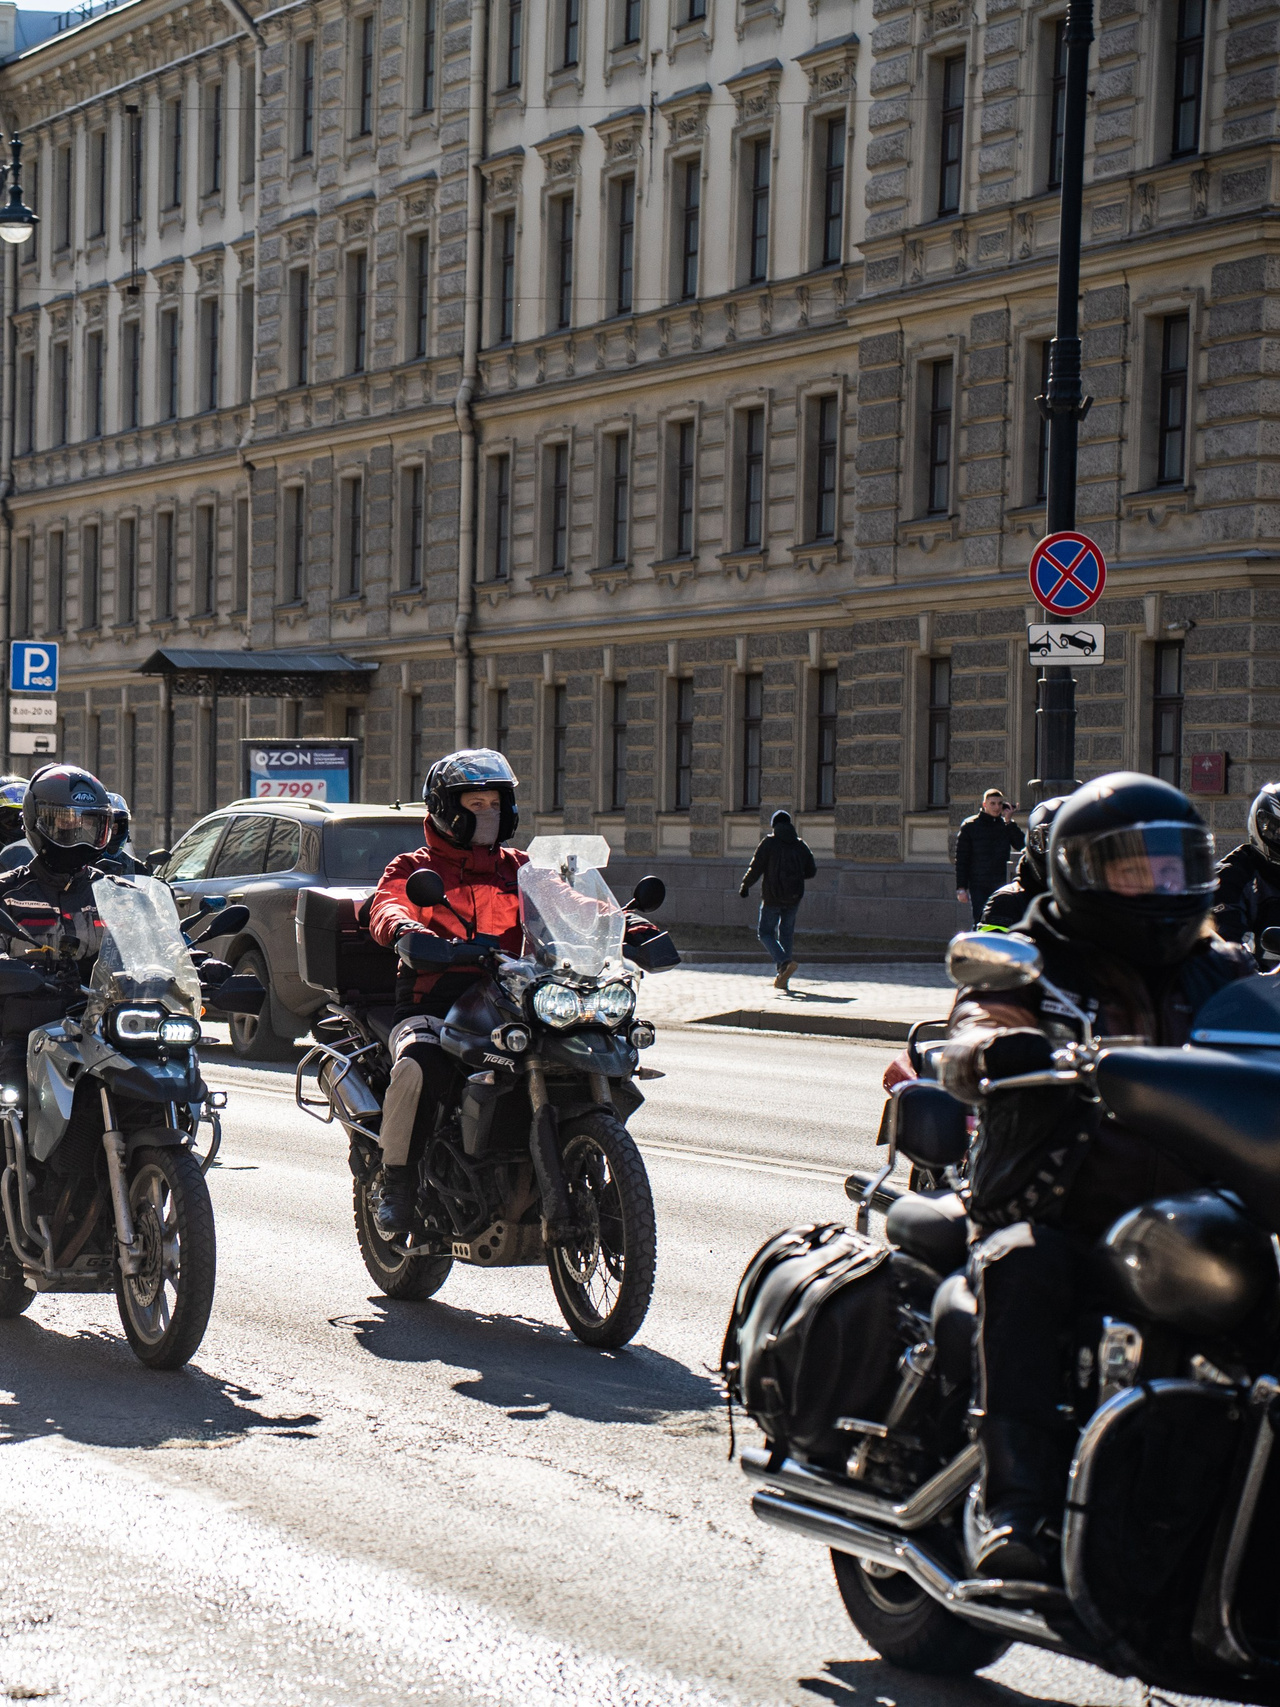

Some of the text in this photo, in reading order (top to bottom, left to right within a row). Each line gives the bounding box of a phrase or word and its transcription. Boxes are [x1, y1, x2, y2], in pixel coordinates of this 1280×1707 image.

[24, 647, 50, 686] P
[255, 752, 311, 766] OZON
[259, 782, 272, 798] 2
[277, 782, 314, 798] 799
[483, 1052, 516, 1073] TIGER
[86, 1257, 113, 1267] GS
